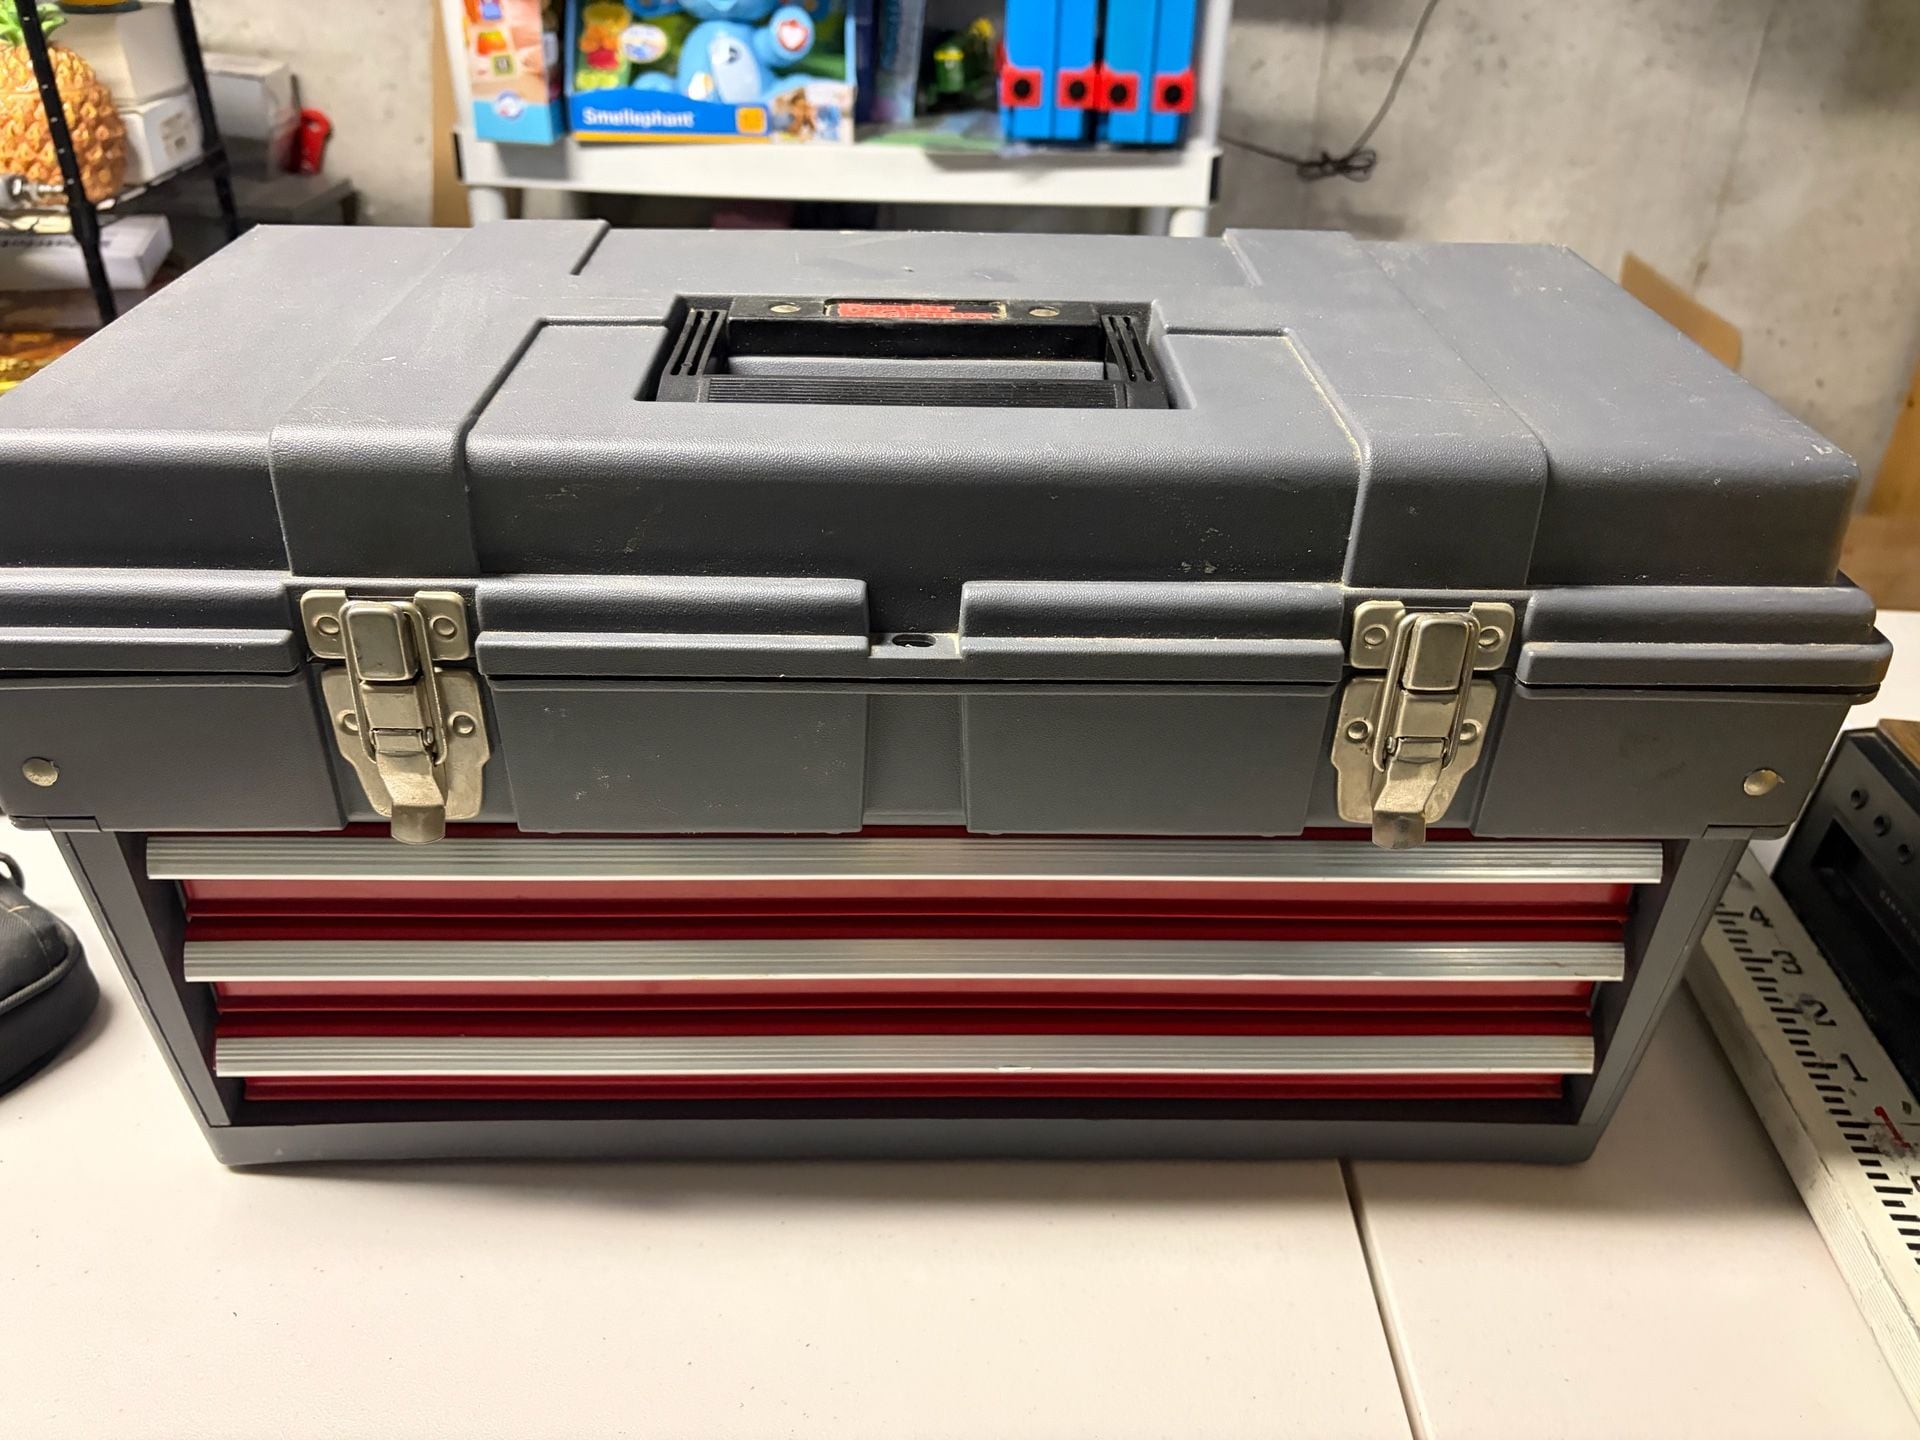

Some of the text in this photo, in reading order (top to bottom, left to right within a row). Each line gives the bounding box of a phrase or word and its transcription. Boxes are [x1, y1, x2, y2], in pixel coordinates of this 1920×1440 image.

[1749, 905, 1774, 928] 4
[1771, 949, 1803, 974] 3
[1840, 1053, 1868, 1082] 1
